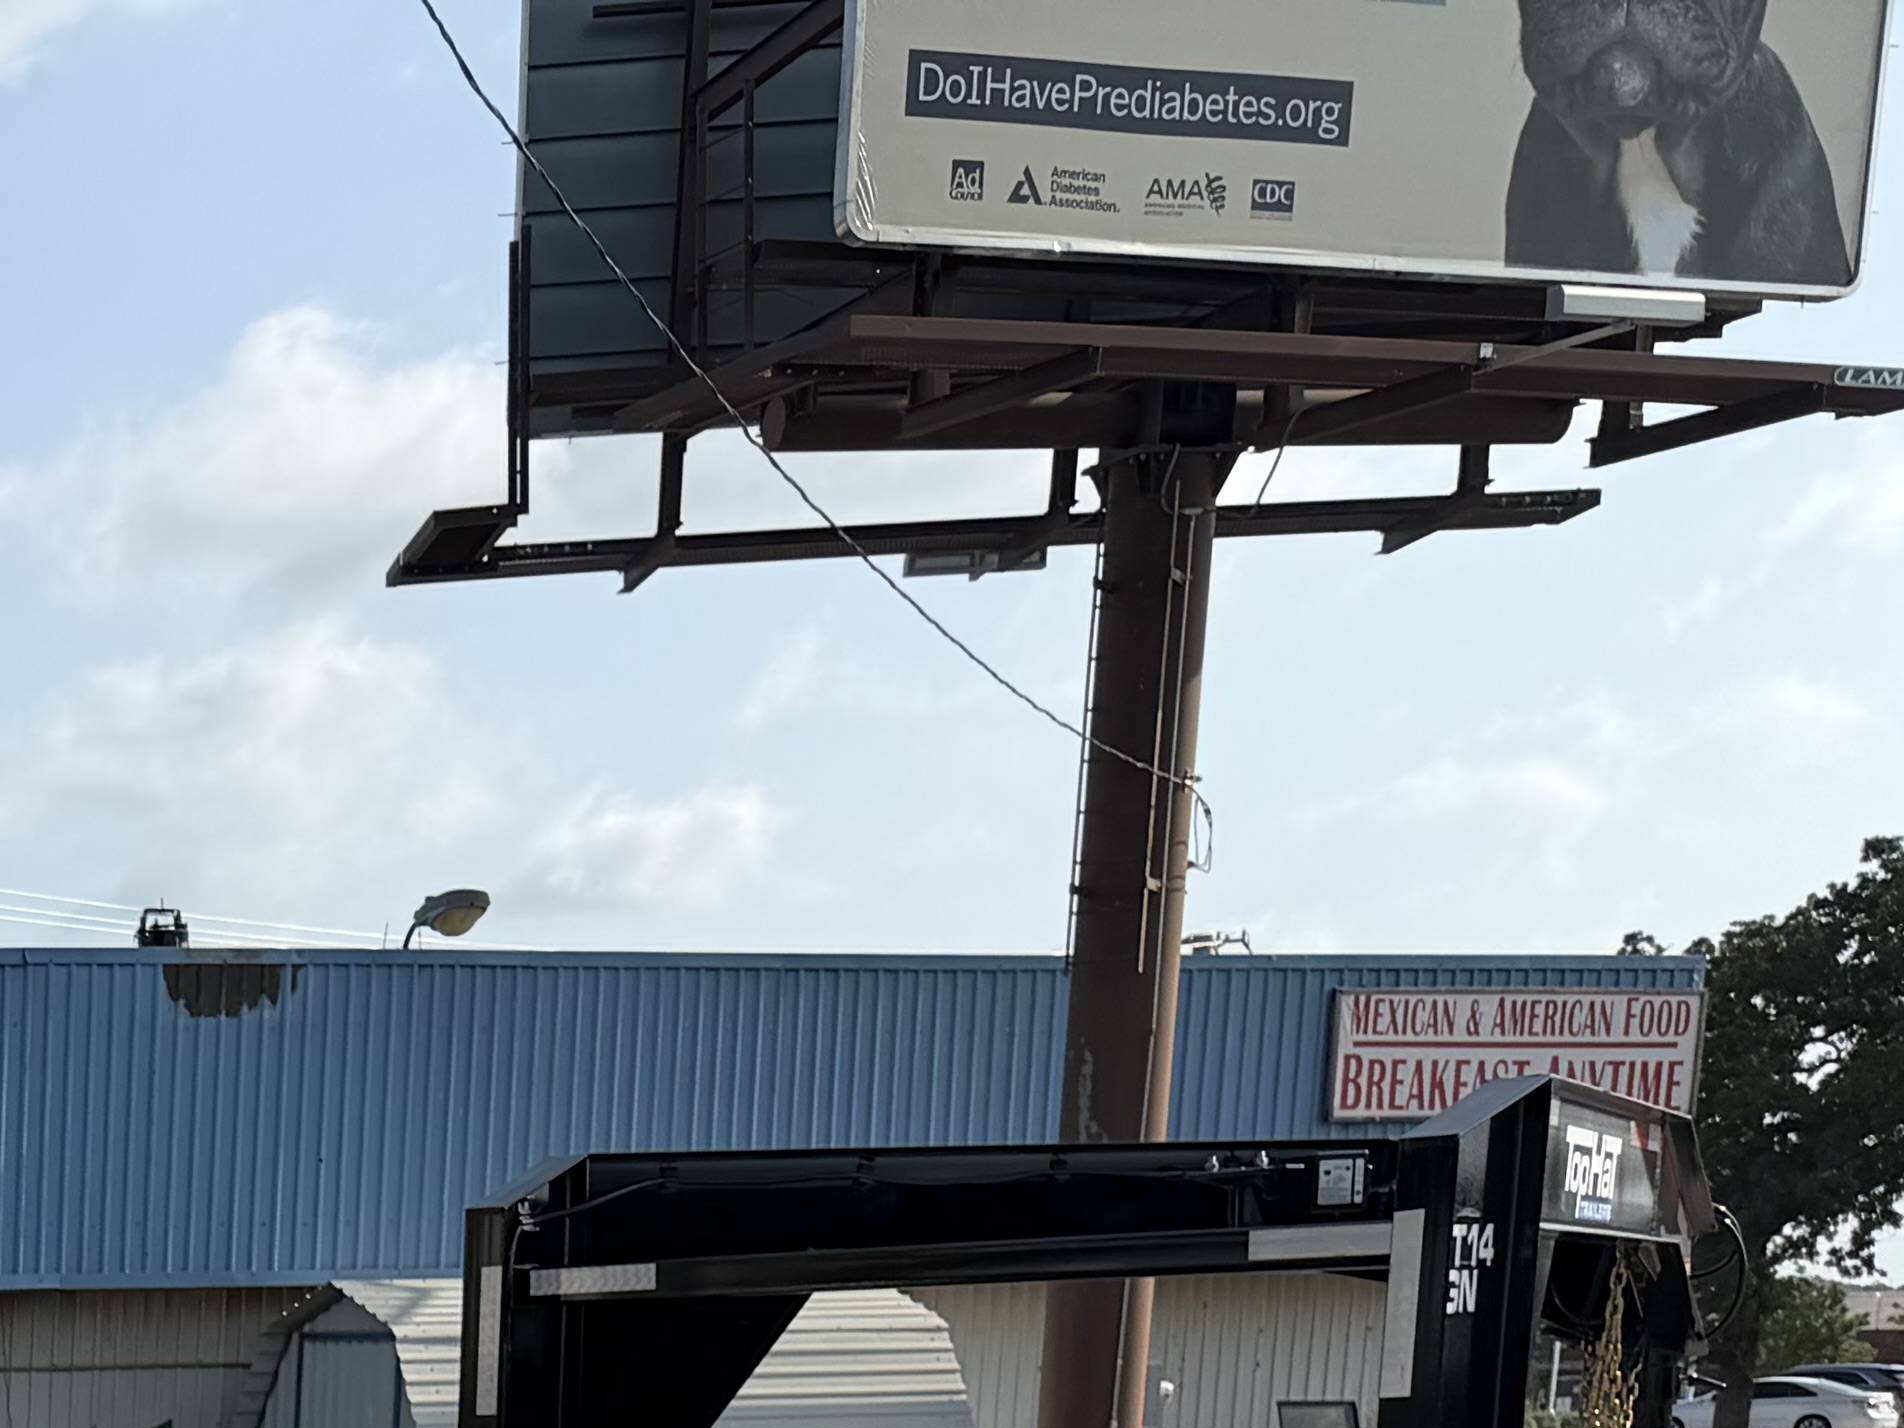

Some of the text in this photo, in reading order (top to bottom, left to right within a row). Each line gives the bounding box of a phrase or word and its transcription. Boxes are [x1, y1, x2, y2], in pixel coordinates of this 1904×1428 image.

[918, 62, 1341, 139] DoIHavePrediabetes.org
[953, 168, 981, 193] Ad
[1051, 166, 1106, 184] American
[1050, 181, 1100, 197] Diabetes
[1146, 178, 1204, 201] AMA
[1254, 183, 1293, 205] CDC
[1350, 994, 1691, 1038] MEXICAN & AMERICAN FOOD
[1453, 1223, 1495, 1268] T14
